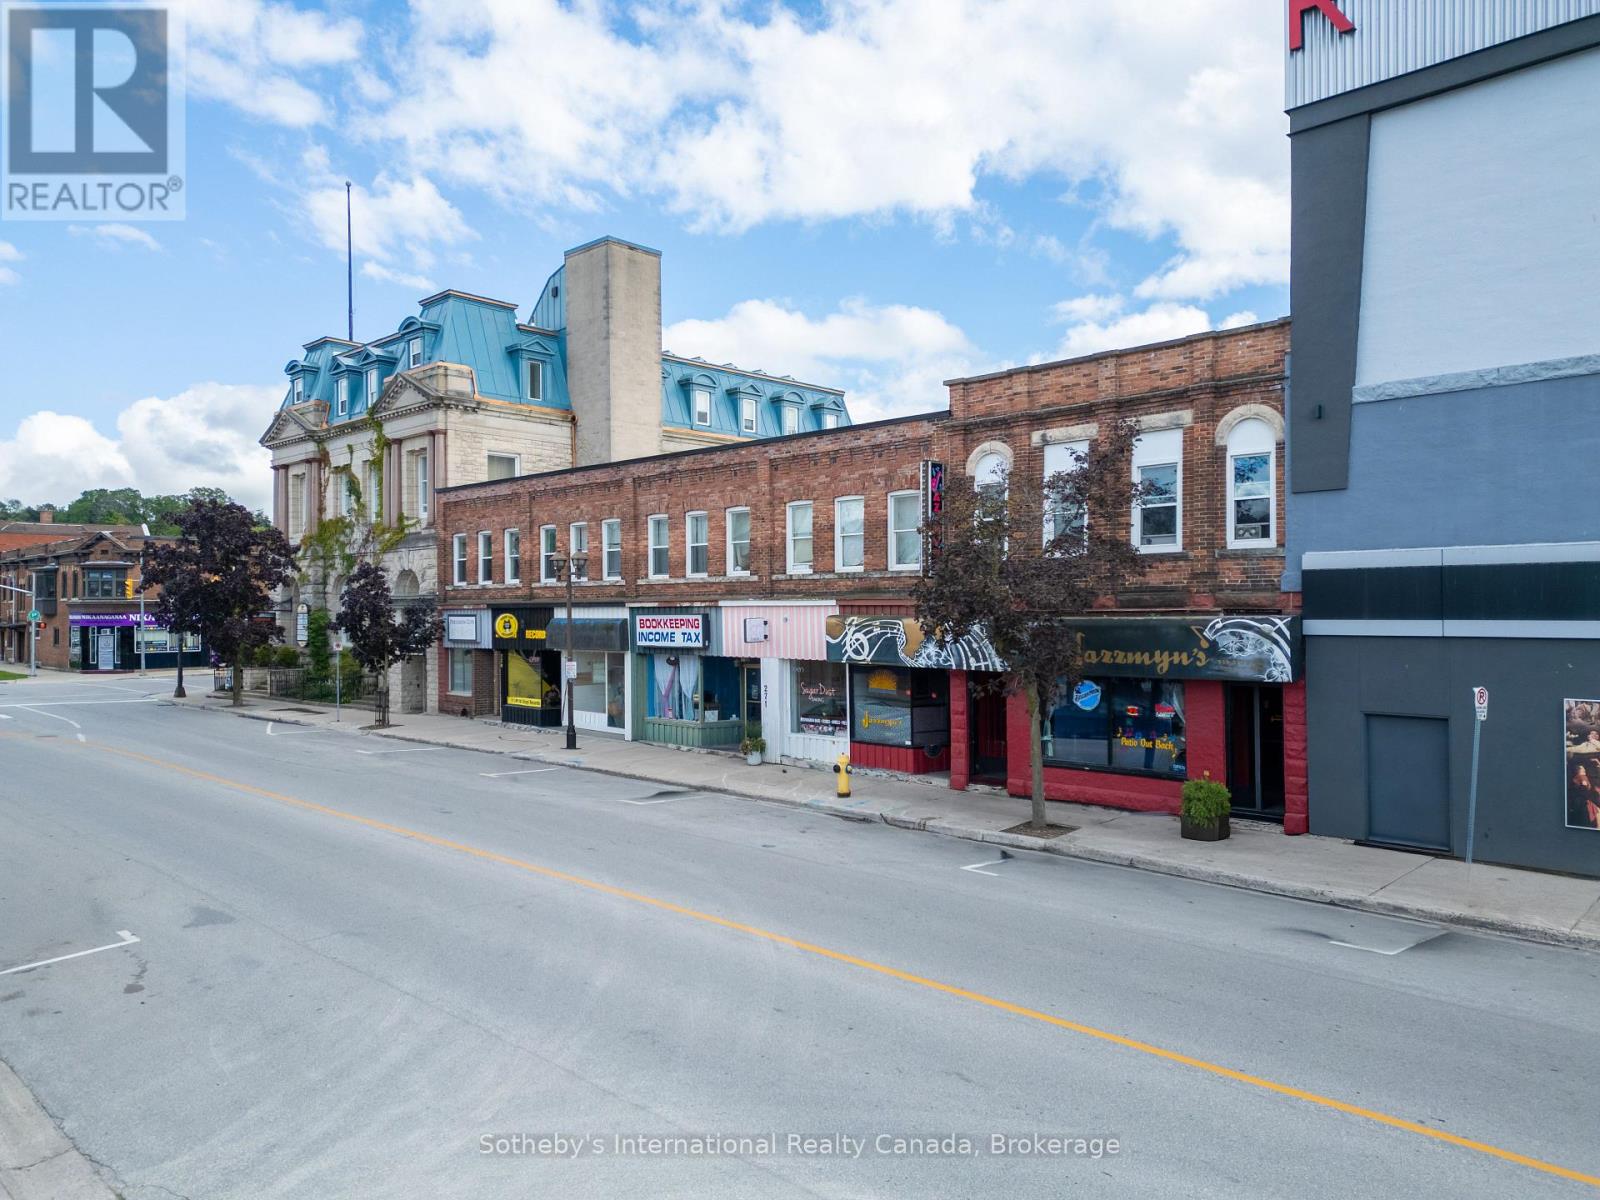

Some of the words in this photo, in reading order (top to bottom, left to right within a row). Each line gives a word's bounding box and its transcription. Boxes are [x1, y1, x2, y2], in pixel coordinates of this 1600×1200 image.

[639, 618, 700, 629] BOOKKEEPING
[638, 631, 676, 642] INCOME
[682, 632, 701, 643] TAX
[1121, 737, 1138, 747] Patio
[1140, 738, 1153, 749] Out
[1155, 739, 1175, 751] Back
